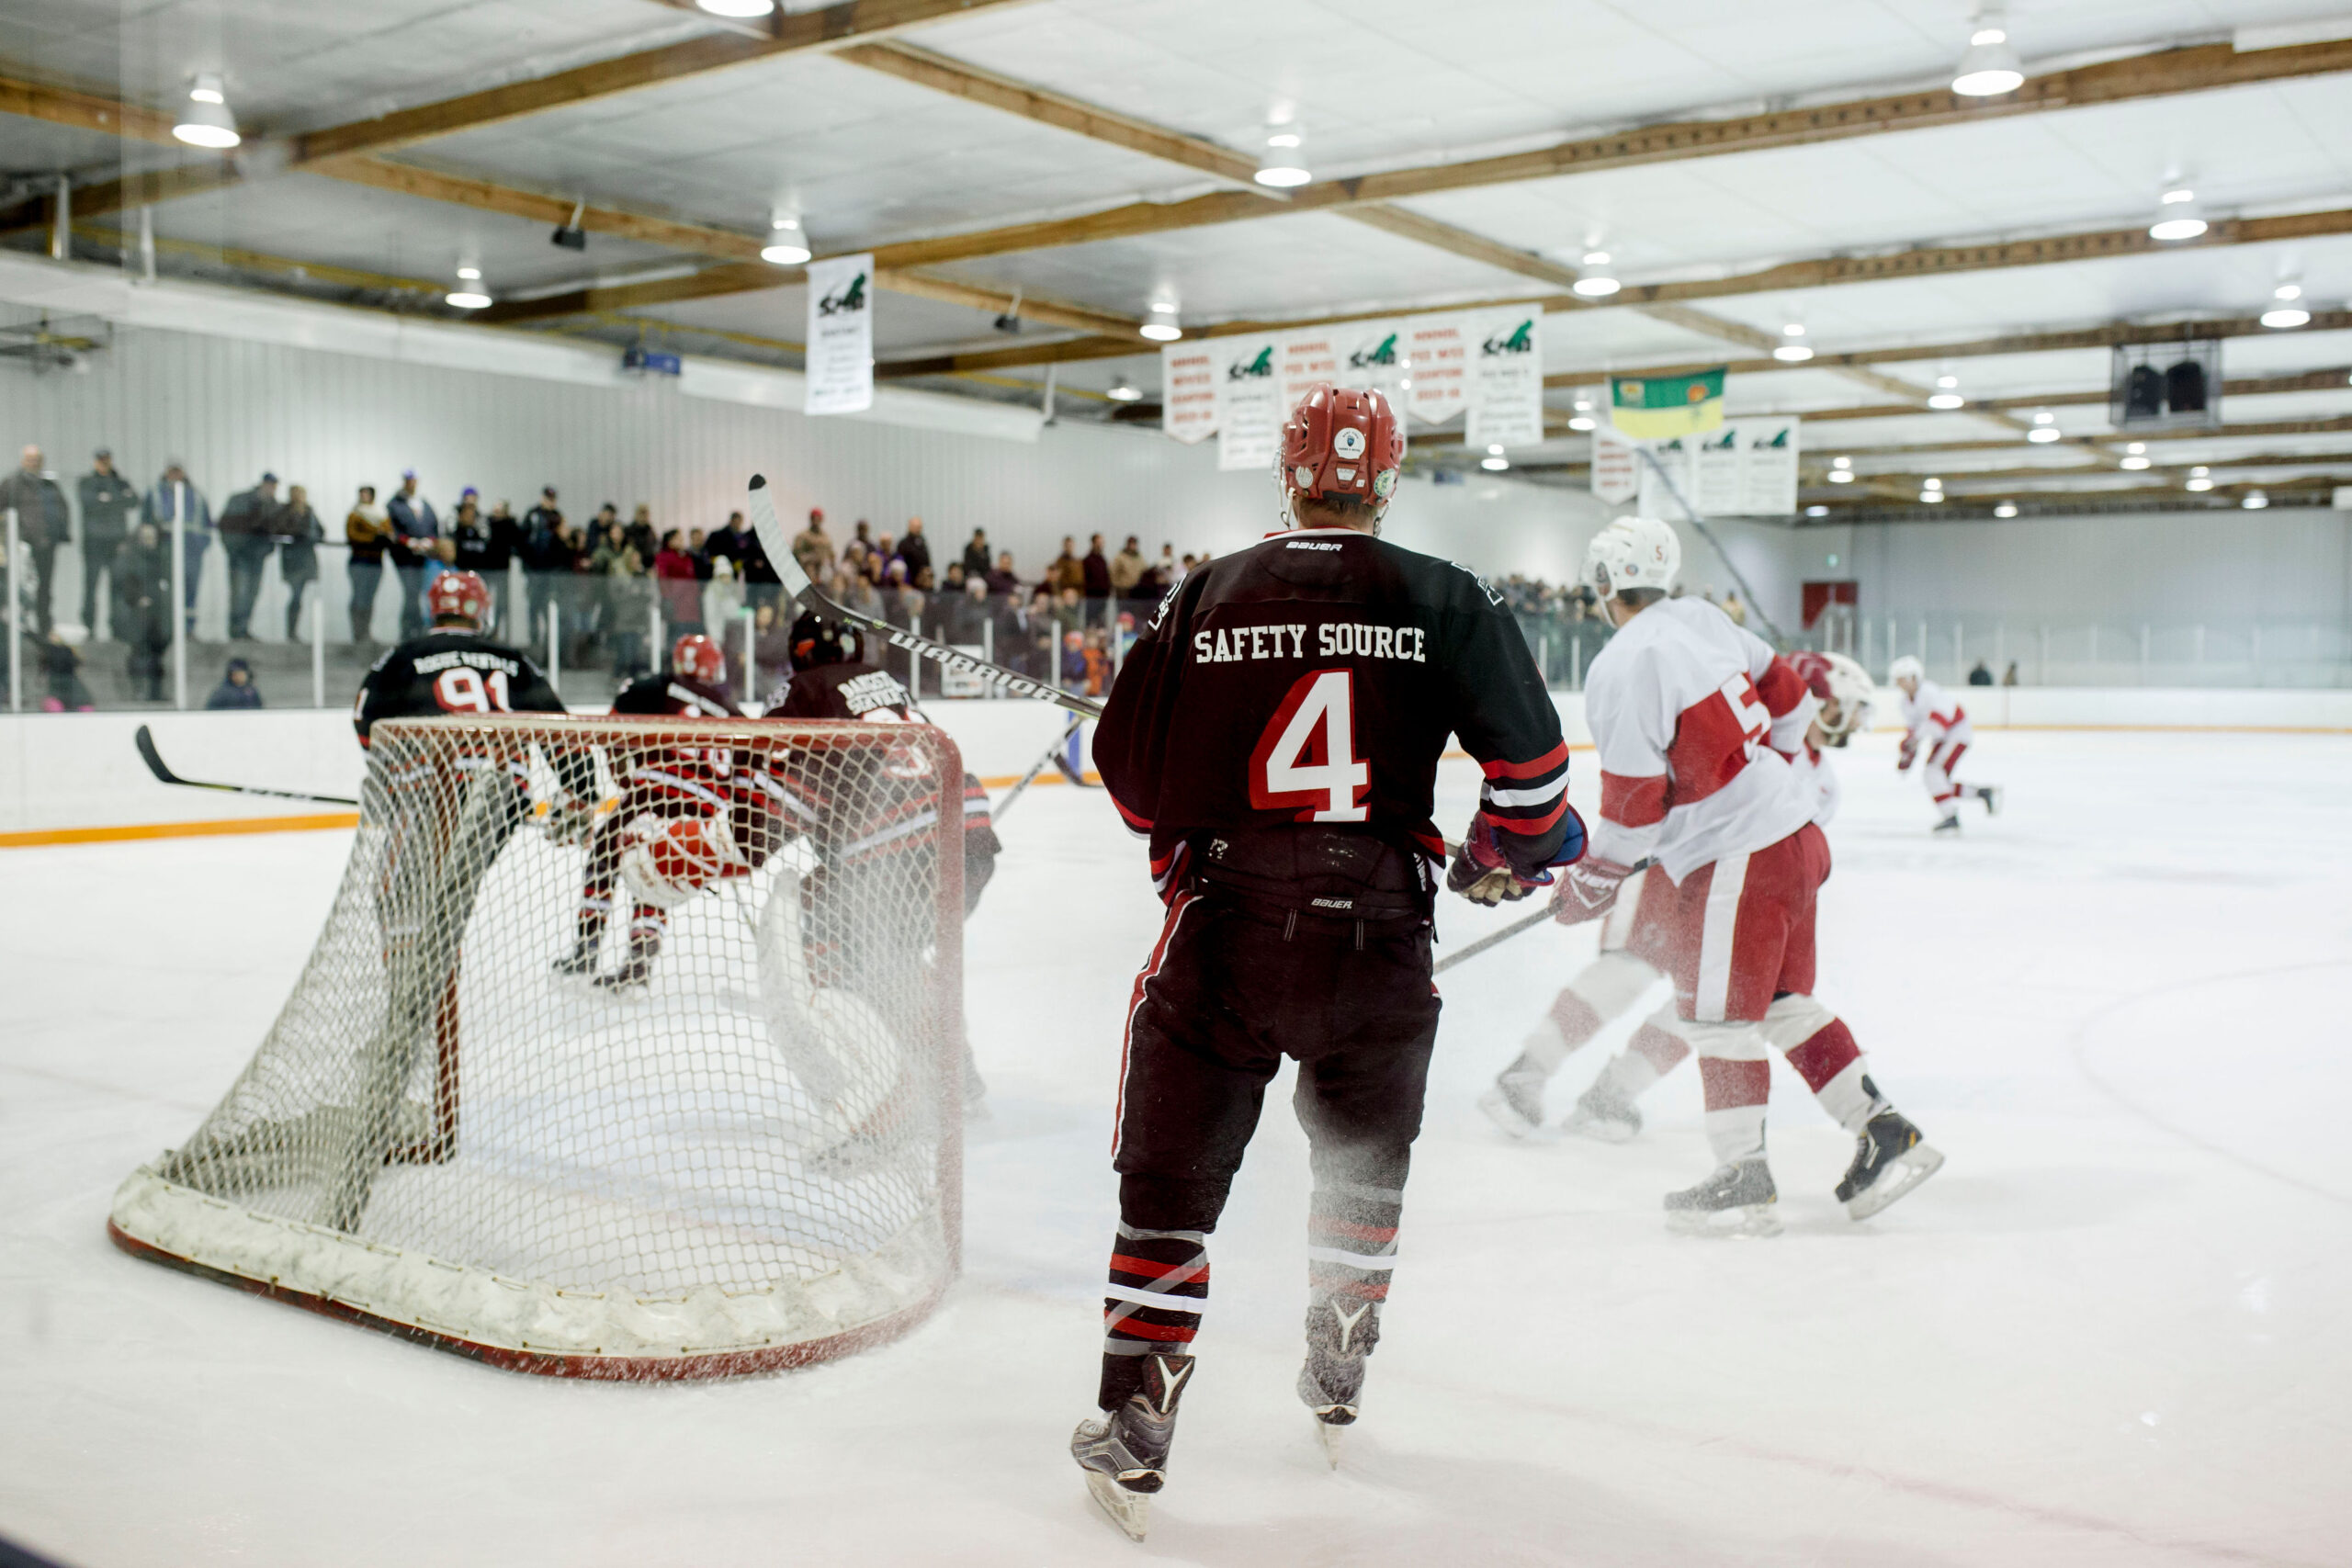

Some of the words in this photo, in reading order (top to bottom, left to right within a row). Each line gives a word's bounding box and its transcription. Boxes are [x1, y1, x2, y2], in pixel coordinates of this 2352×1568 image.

[1286, 541, 1343, 551] BAUER
[1194, 624, 1306, 663] SAFETY
[1318, 623, 1426, 663] SOURCE
[434, 666, 514, 713] 91
[888, 631, 1061, 705] WARRIOR
[1720, 671, 1772, 761] 5
[1255, 669, 1370, 822] 4
[1311, 897, 1352, 909] BAUER
